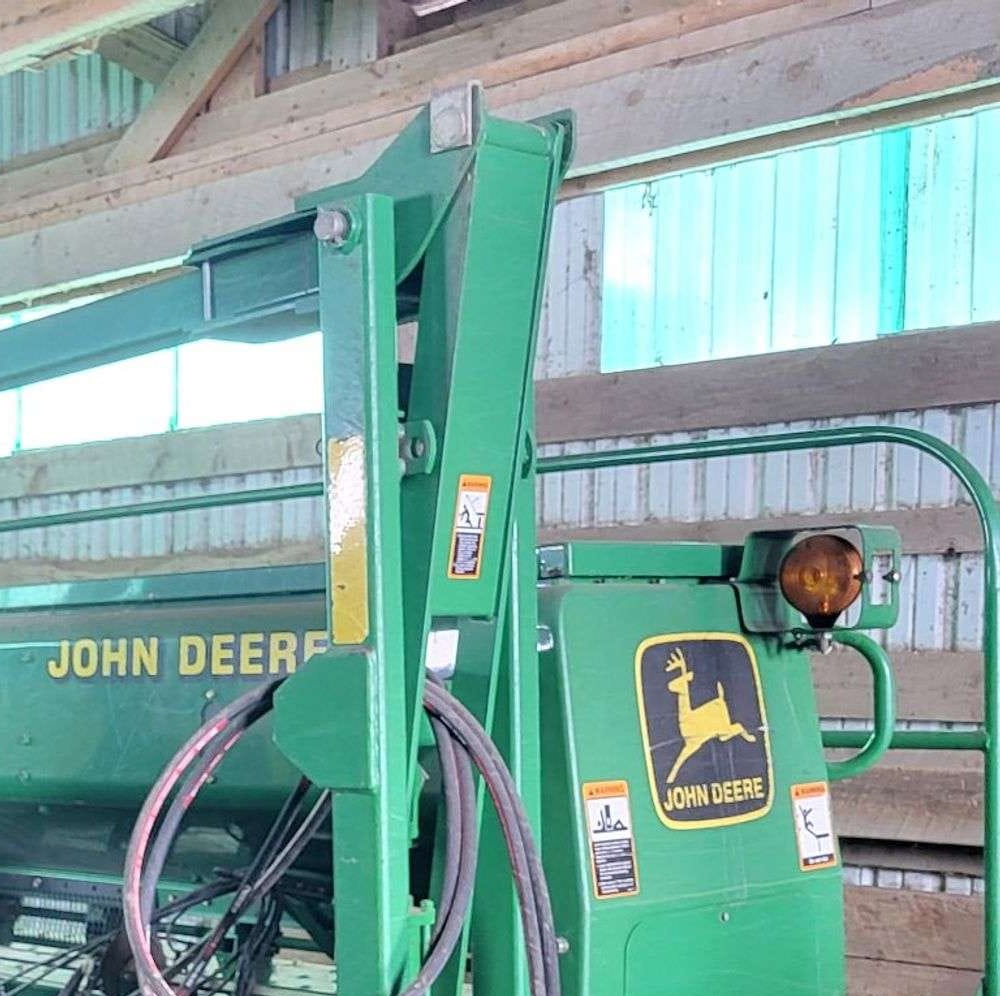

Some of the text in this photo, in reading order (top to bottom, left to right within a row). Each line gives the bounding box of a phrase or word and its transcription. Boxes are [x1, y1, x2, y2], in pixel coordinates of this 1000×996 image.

[48, 637, 158, 678] JOHN
[663, 777, 765, 811] JOHN DEERE
